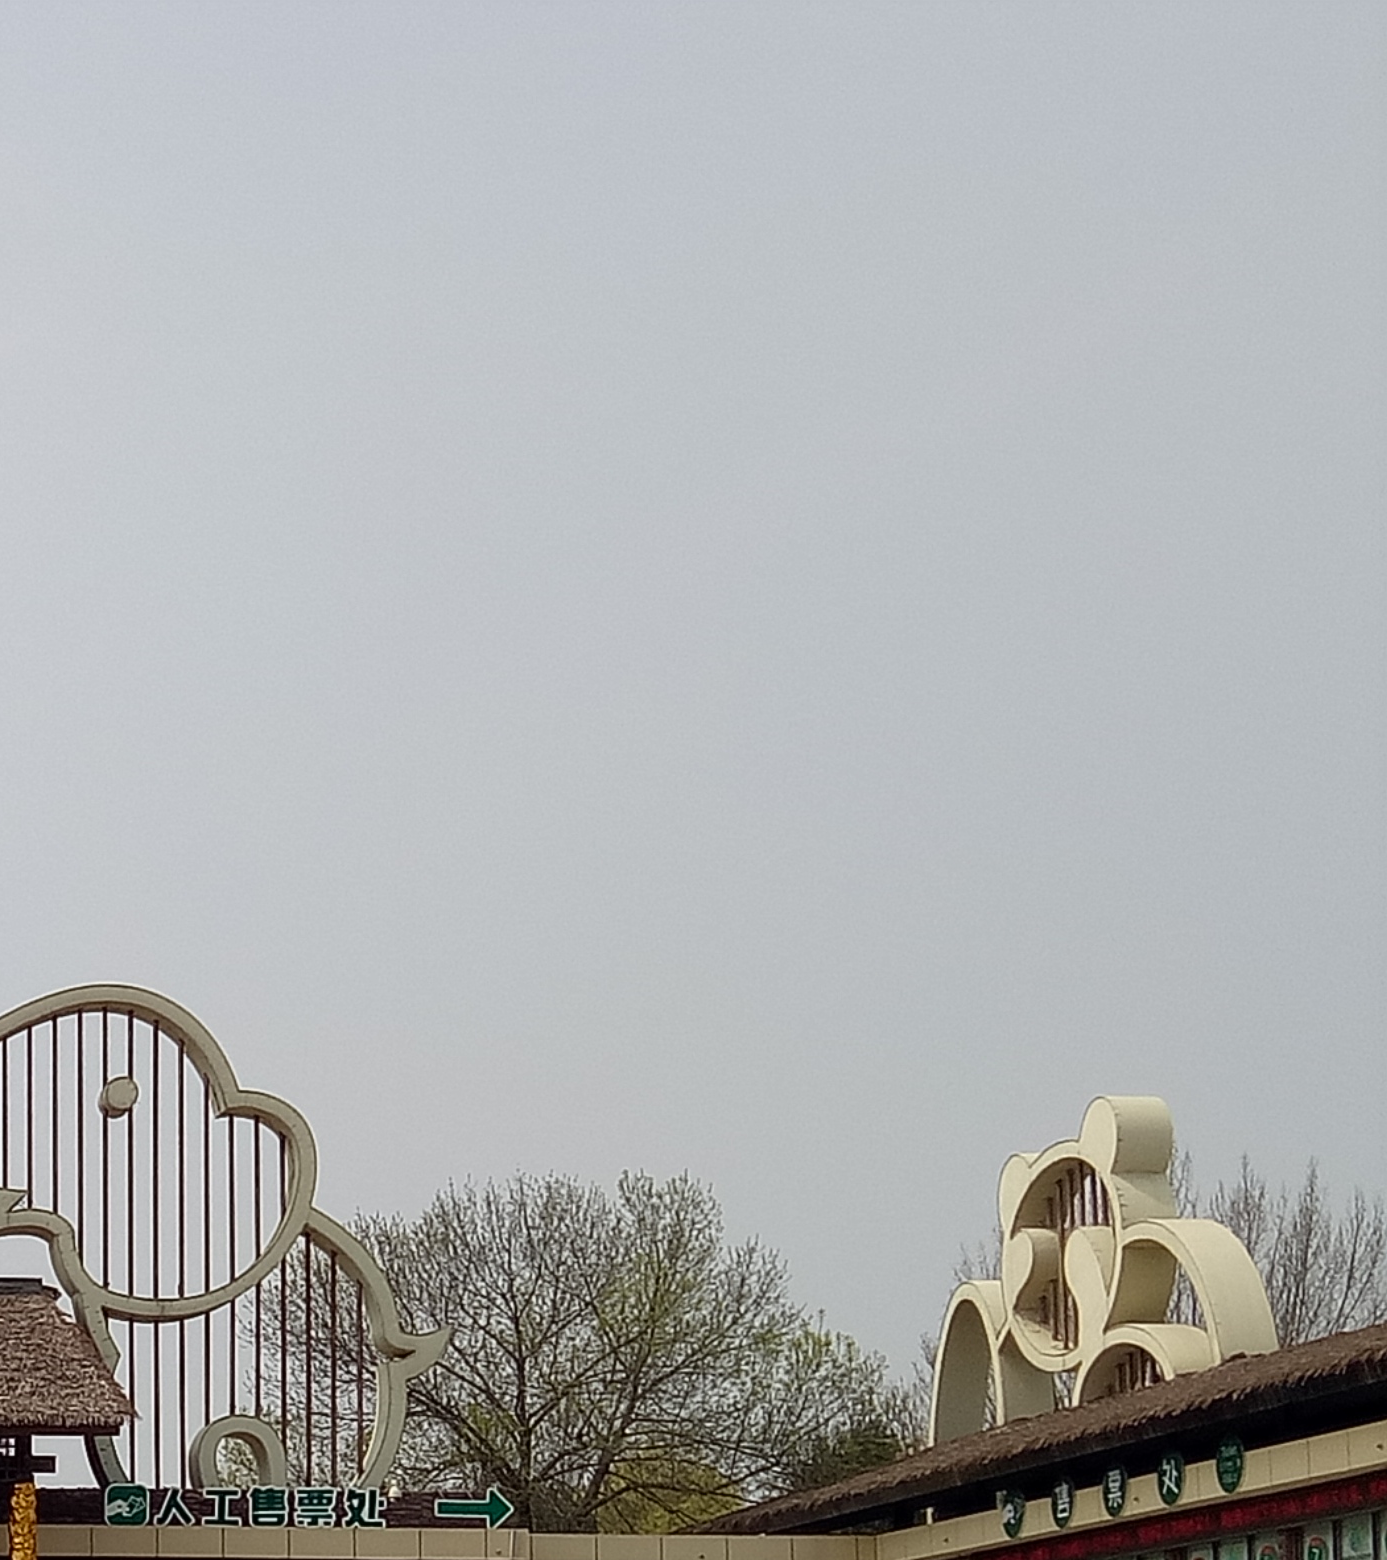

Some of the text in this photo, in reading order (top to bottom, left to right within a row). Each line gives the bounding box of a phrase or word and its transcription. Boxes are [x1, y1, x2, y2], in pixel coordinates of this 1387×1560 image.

[154, 1488, 386, 1528] 人工售票处
